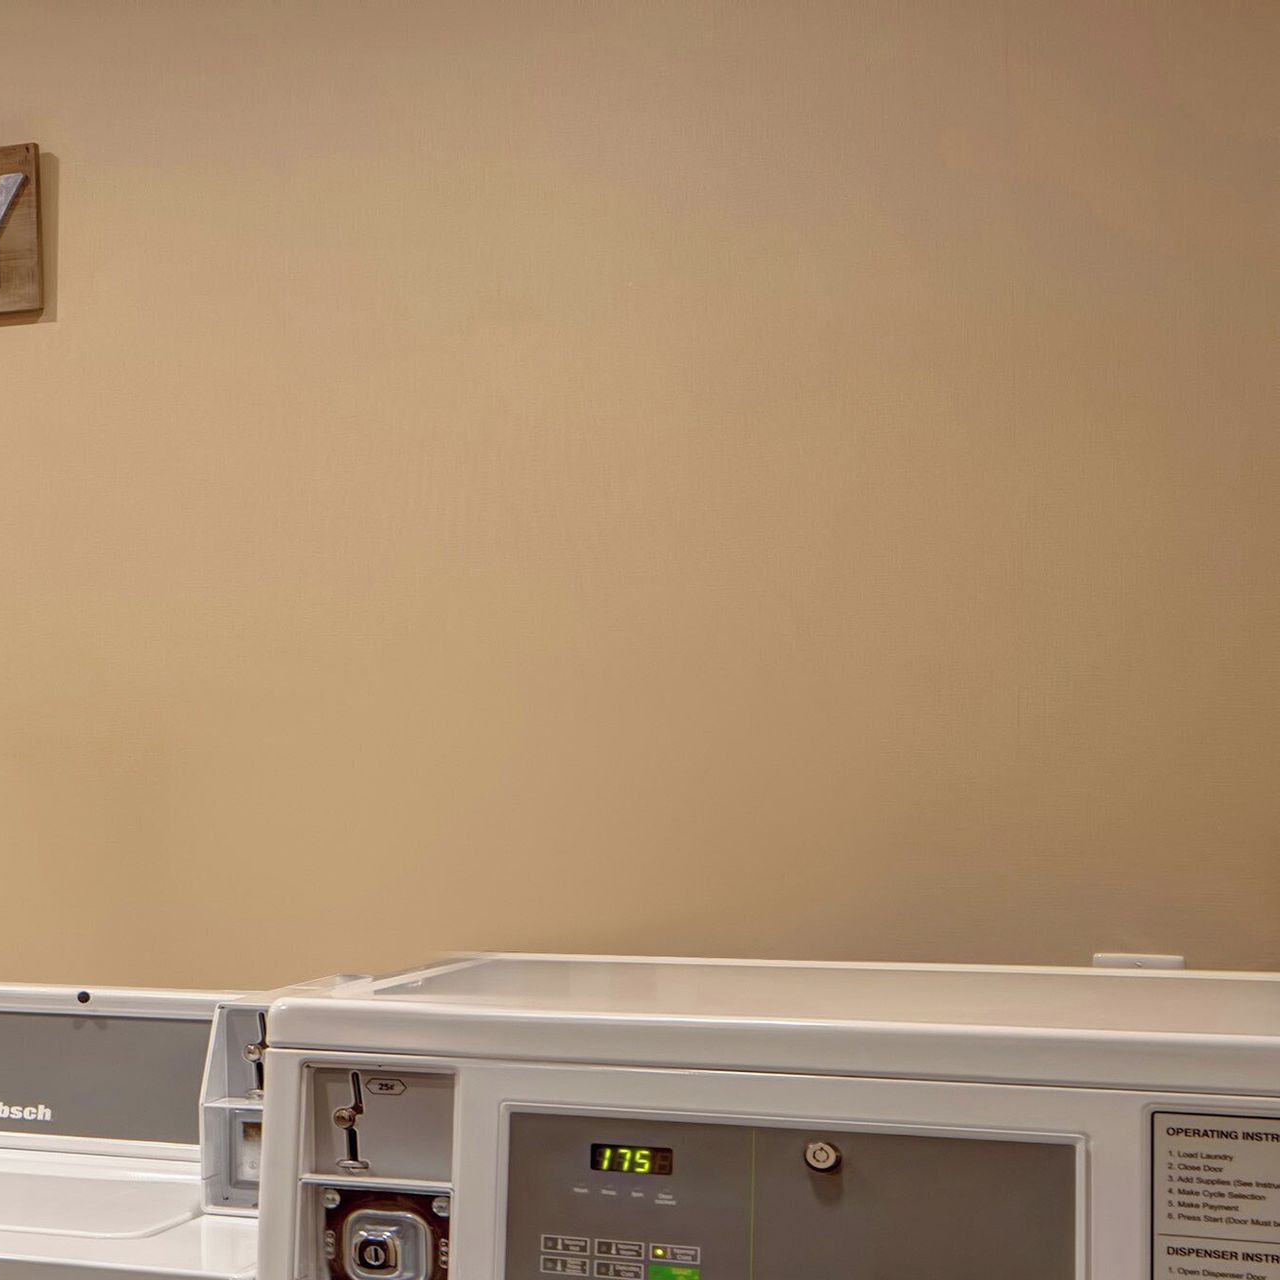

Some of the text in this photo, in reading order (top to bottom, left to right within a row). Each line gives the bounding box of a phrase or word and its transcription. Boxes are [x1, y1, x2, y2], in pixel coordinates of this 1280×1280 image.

[1167, 1127, 1238, 1140] OPERATING
[601, 1148, 651, 1172] 175
[1200, 1152, 1233, 1161] Laundry
[1178, 1163, 1201, 1171] Close
[1196, 1177, 1231, 1186] Supplies
[1233, 1179, 1253, 1188] (See
[1202, 1190, 1225, 1198] Cycle
[1228, 1192, 1266, 1200] Selection
[1202, 1203, 1239, 1212] Payment
[1178, 1213, 1201, 1221] Press
[1203, 1215, 1222, 1223] Start
[1226, 1217, 1248, 1225] (Door
[1251, 1218, 1271, 1227] Must
[1167, 1246, 1238, 1261] DISPENSER
[1177, 1268, 1199, 1277] Open
[1202, 1269, 1243, 1280] Dispenser
[1246, 1273, 1267, 1280] Door
